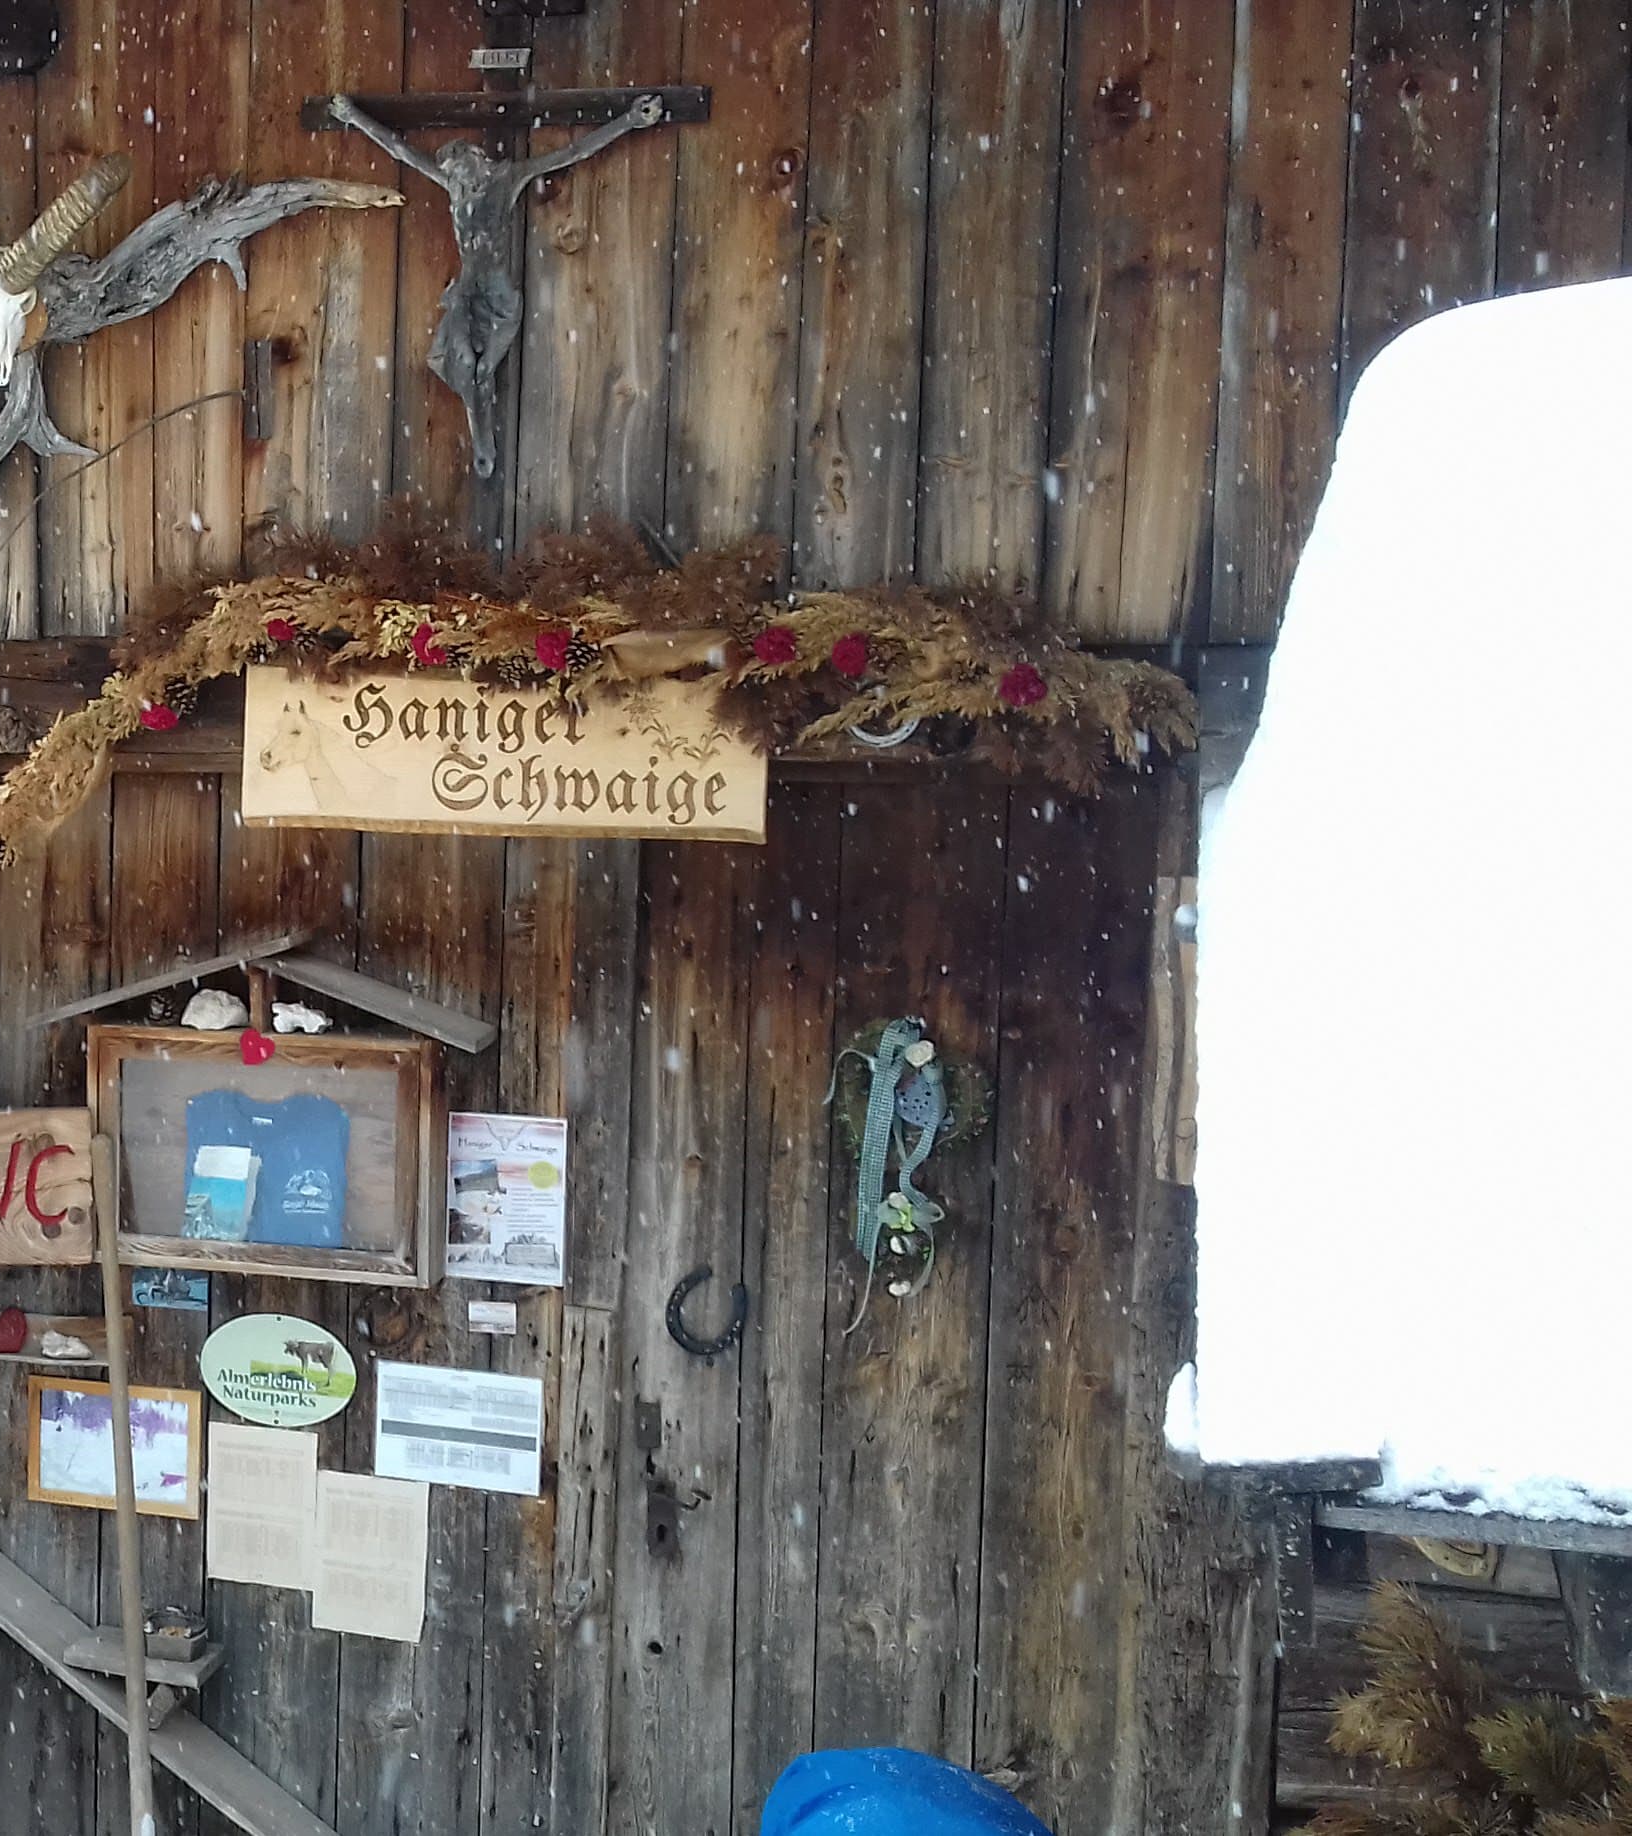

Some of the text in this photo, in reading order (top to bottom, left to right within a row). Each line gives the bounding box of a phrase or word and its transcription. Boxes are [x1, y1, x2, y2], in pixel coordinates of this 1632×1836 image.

[431, 744, 728, 824] Schwaige
[217, 1368, 317, 1393] Almerlebnis
[223, 1384, 317, 1408] Naturparks
